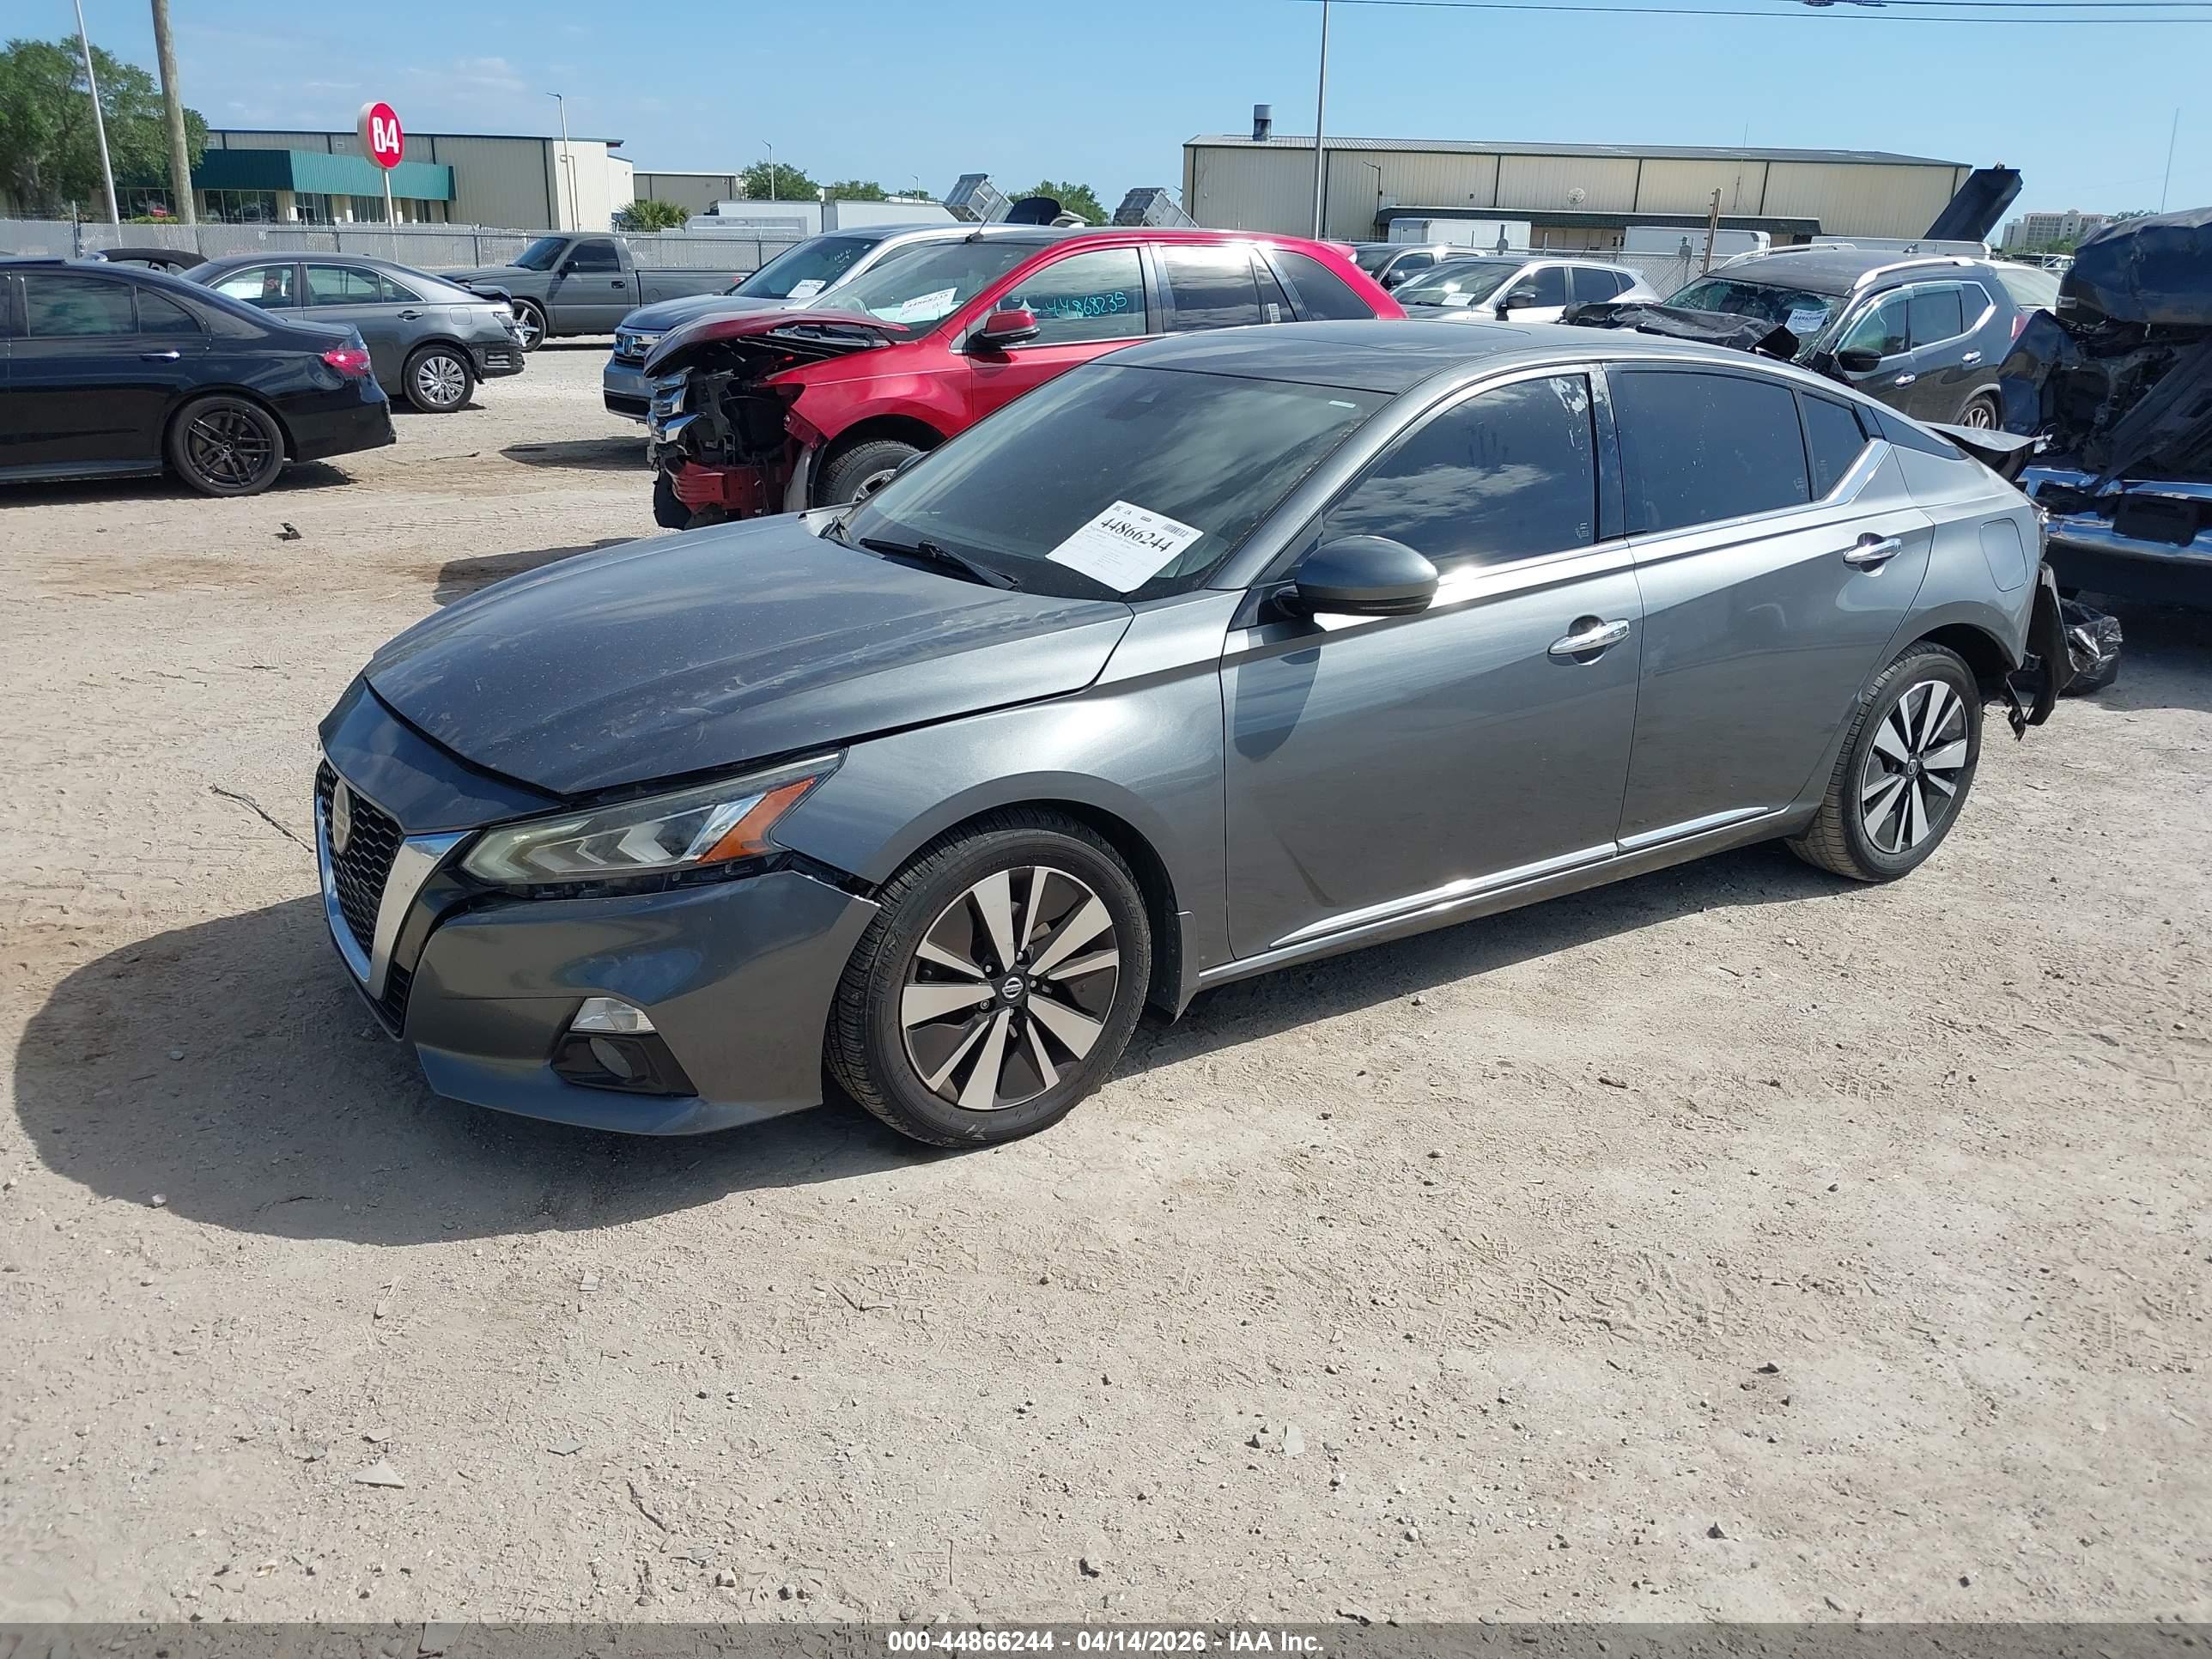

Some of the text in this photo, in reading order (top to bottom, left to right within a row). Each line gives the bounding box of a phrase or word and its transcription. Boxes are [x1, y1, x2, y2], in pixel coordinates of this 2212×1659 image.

[372, 117, 400, 155] 84
[1045, 291, 1128, 318] 44868235
[1100, 517, 1176, 552] 44866244
